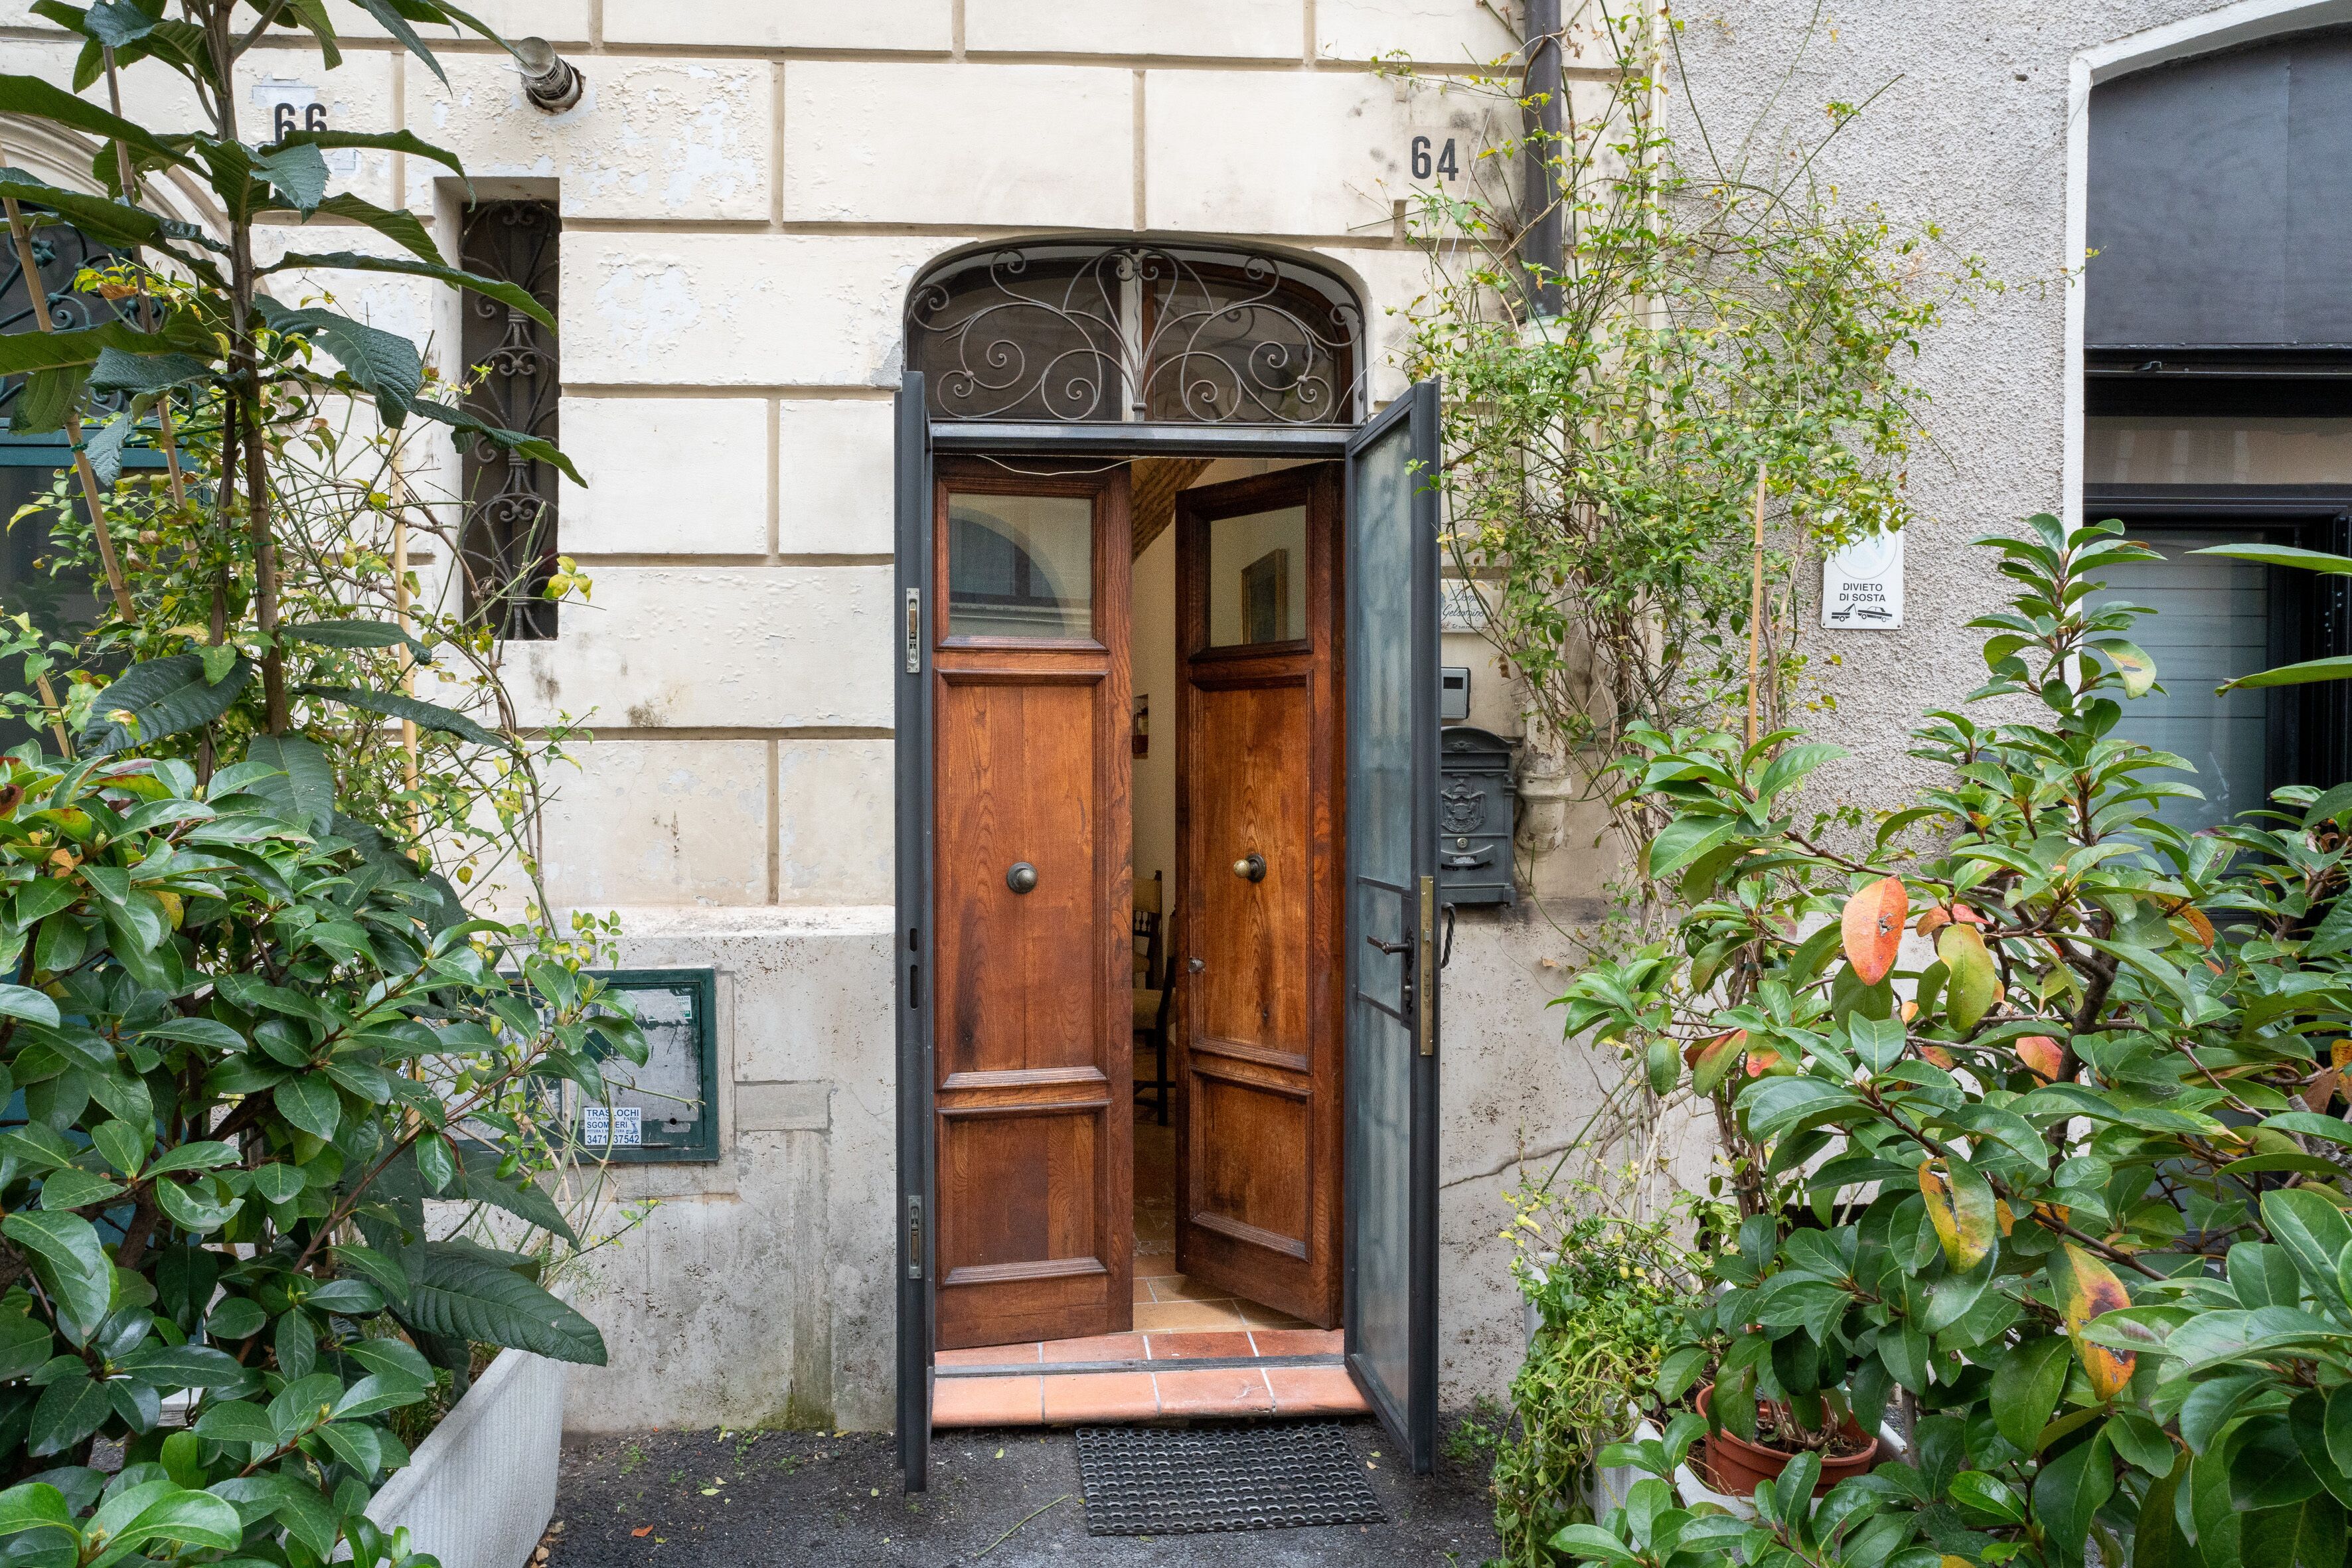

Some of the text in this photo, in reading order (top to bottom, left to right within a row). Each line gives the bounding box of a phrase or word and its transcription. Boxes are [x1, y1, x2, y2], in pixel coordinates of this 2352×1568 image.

[275, 103, 327, 144] 66
[1412, 136, 1458, 181] 64
[1843, 583, 1883, 591] DIVIETO
[1852, 593, 1886, 602] SOSTA
[587, 1135, 639, 1143] 347137542
